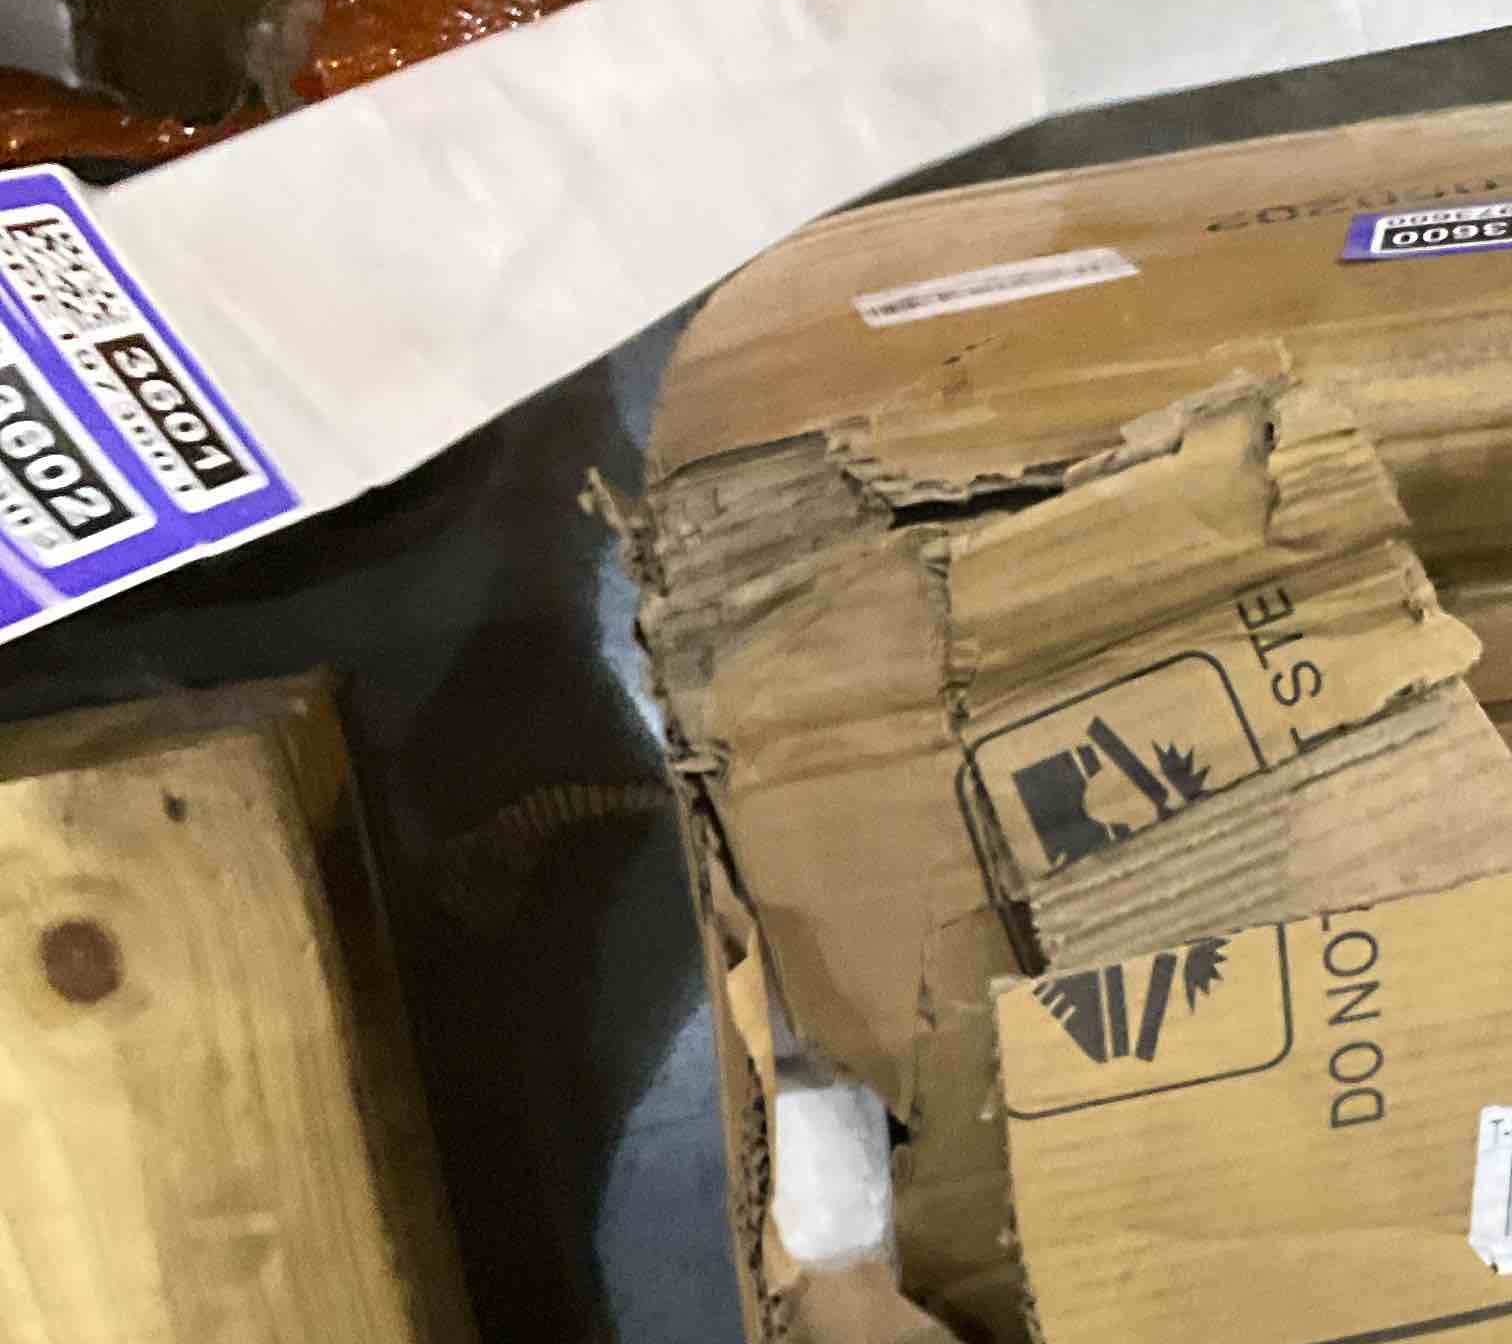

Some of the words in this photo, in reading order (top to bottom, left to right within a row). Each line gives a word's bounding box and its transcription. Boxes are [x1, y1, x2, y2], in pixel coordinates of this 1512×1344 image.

[1392, 219, 1507, 248] 3600
[112, 344, 234, 472] 3601
[1236, 588, 1323, 708] STE
[1329, 1041, 1385, 1129] DO
